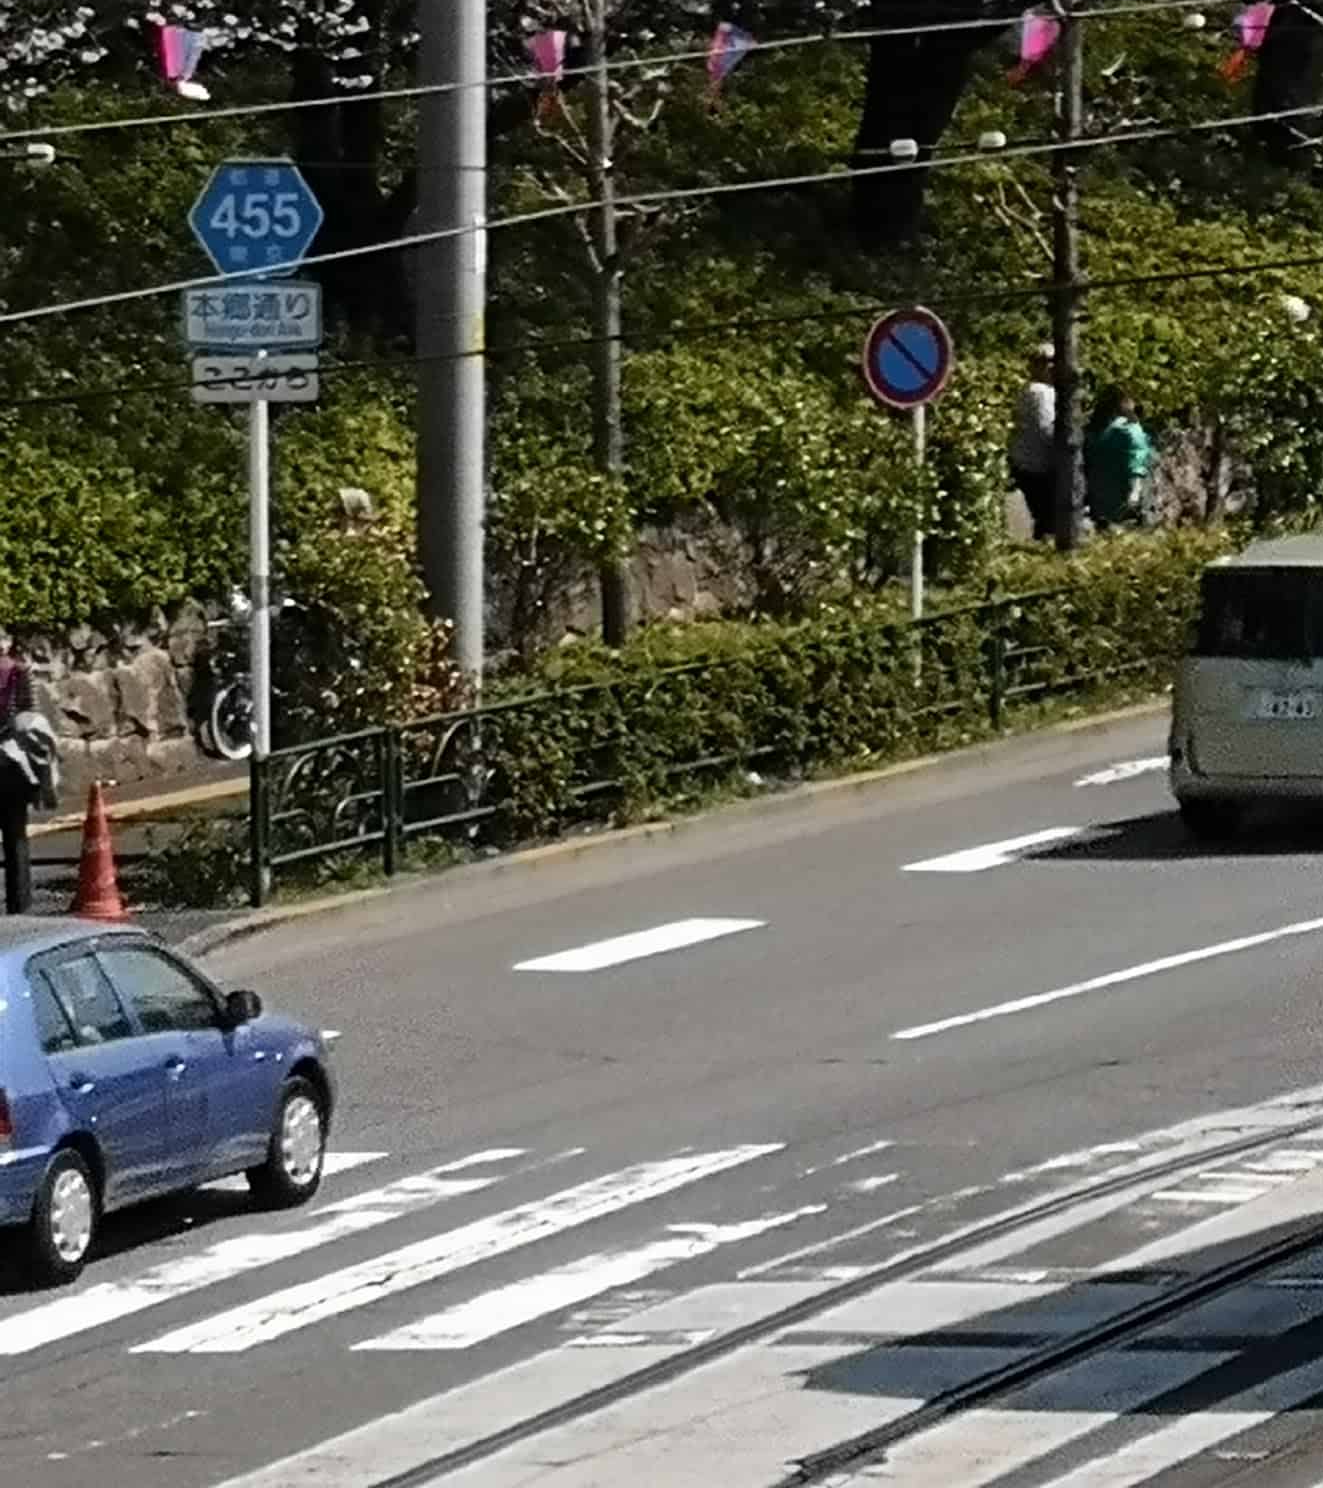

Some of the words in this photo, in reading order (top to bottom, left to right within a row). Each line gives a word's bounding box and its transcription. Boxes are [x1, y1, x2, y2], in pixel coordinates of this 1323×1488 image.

[209, 192, 301, 238] 455
[203, 366, 309, 390] ここから
